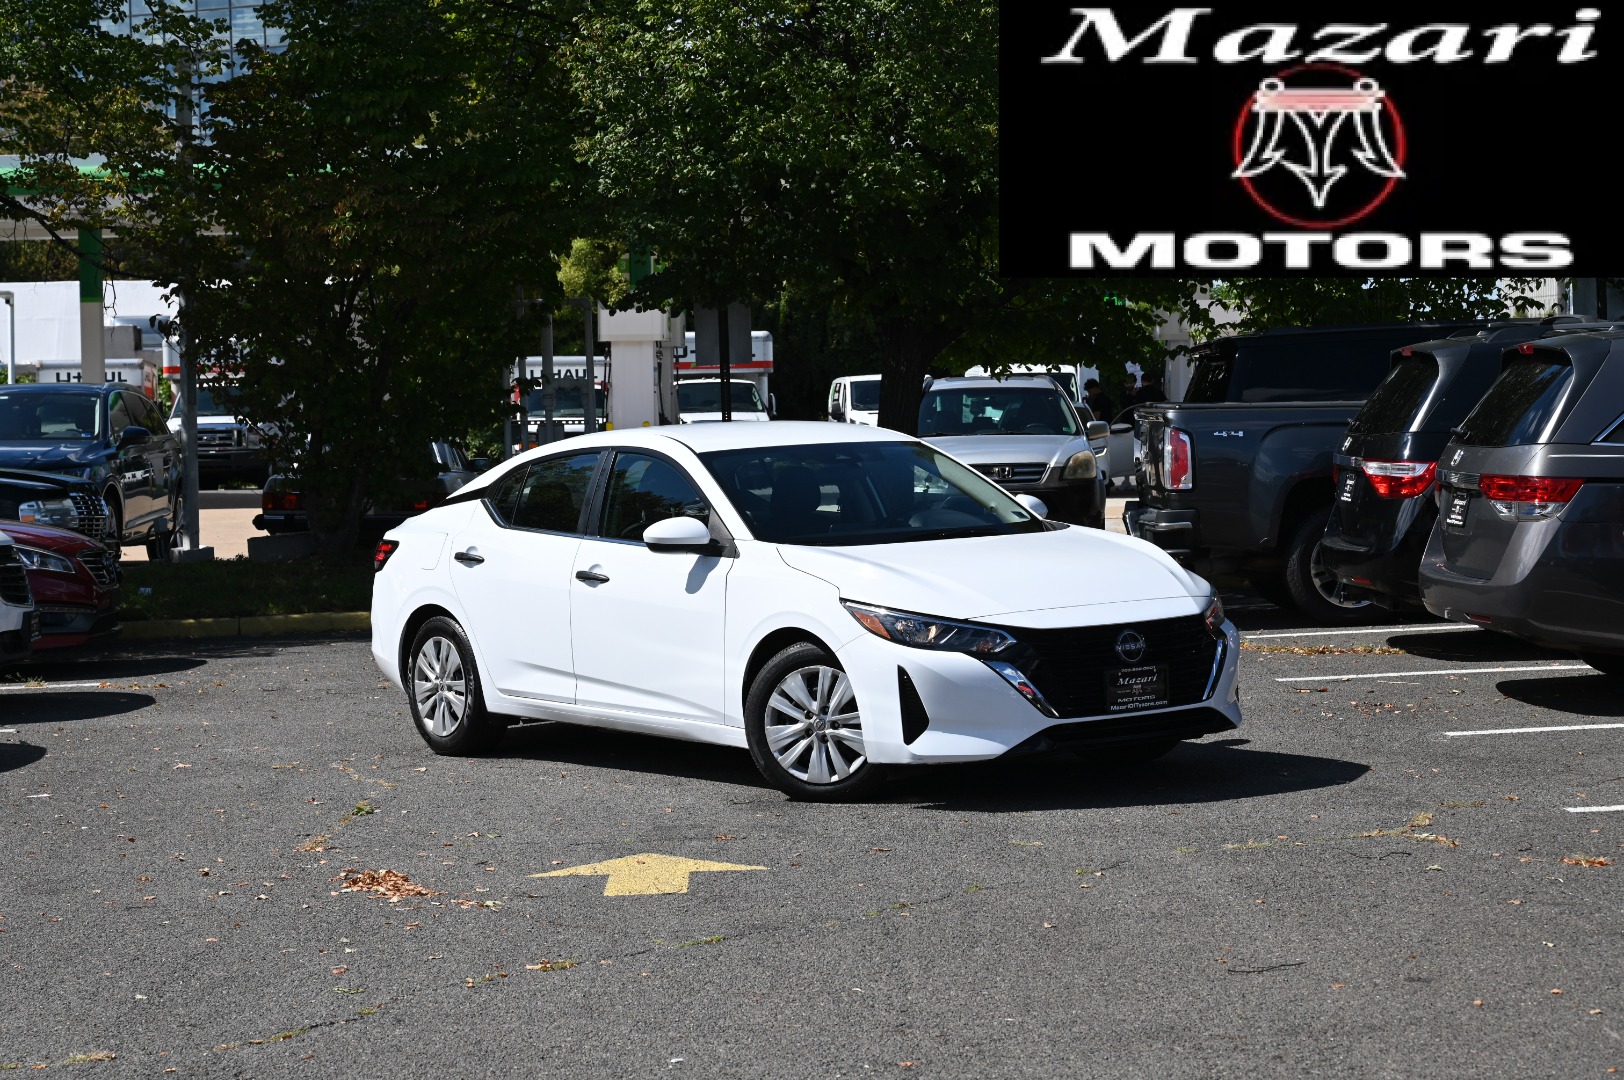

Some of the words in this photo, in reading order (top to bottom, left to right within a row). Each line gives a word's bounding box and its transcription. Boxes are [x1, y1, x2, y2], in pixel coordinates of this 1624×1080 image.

[1115, 642, 1146, 652] NISSAN
[1116, 673, 1158, 686] Mazari
[1117, 694, 1156, 703] MOTORS
